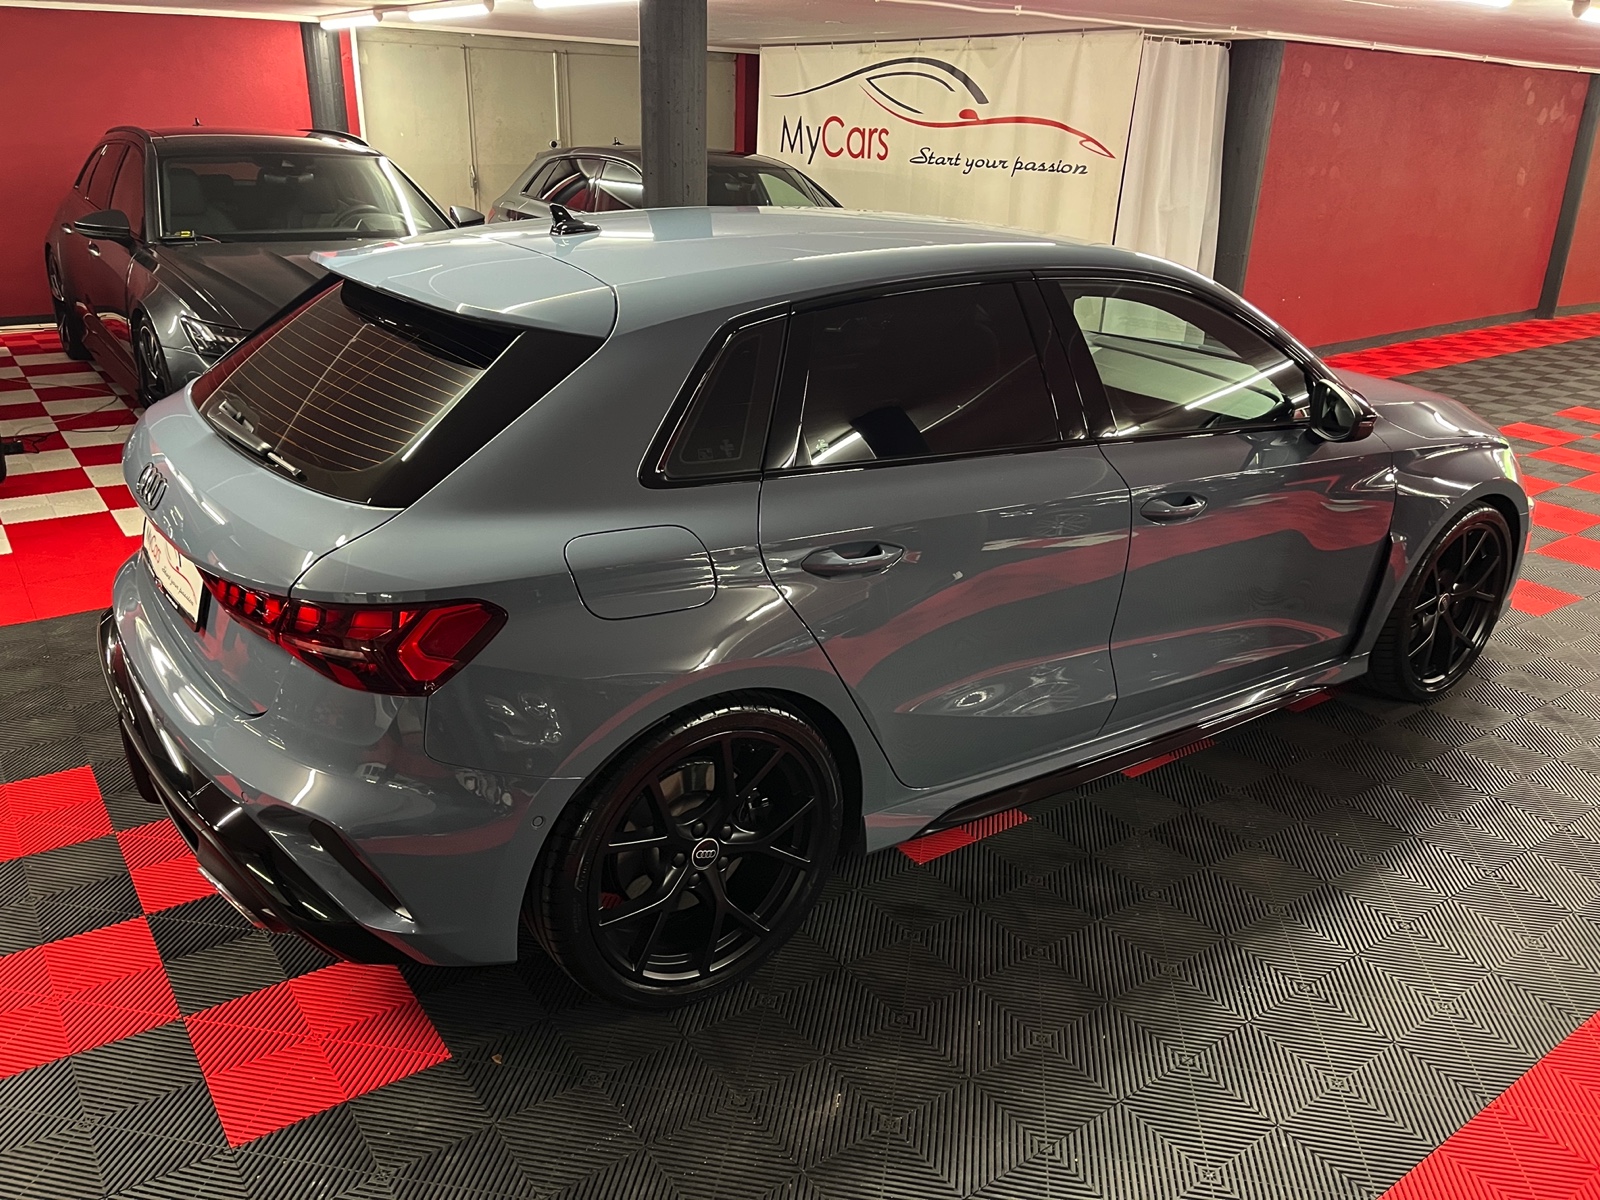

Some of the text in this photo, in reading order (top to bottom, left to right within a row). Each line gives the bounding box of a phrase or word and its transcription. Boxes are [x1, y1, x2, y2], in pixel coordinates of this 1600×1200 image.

[780, 115, 889, 165] MyCars
[909, 146, 1088, 177] Start your passion
